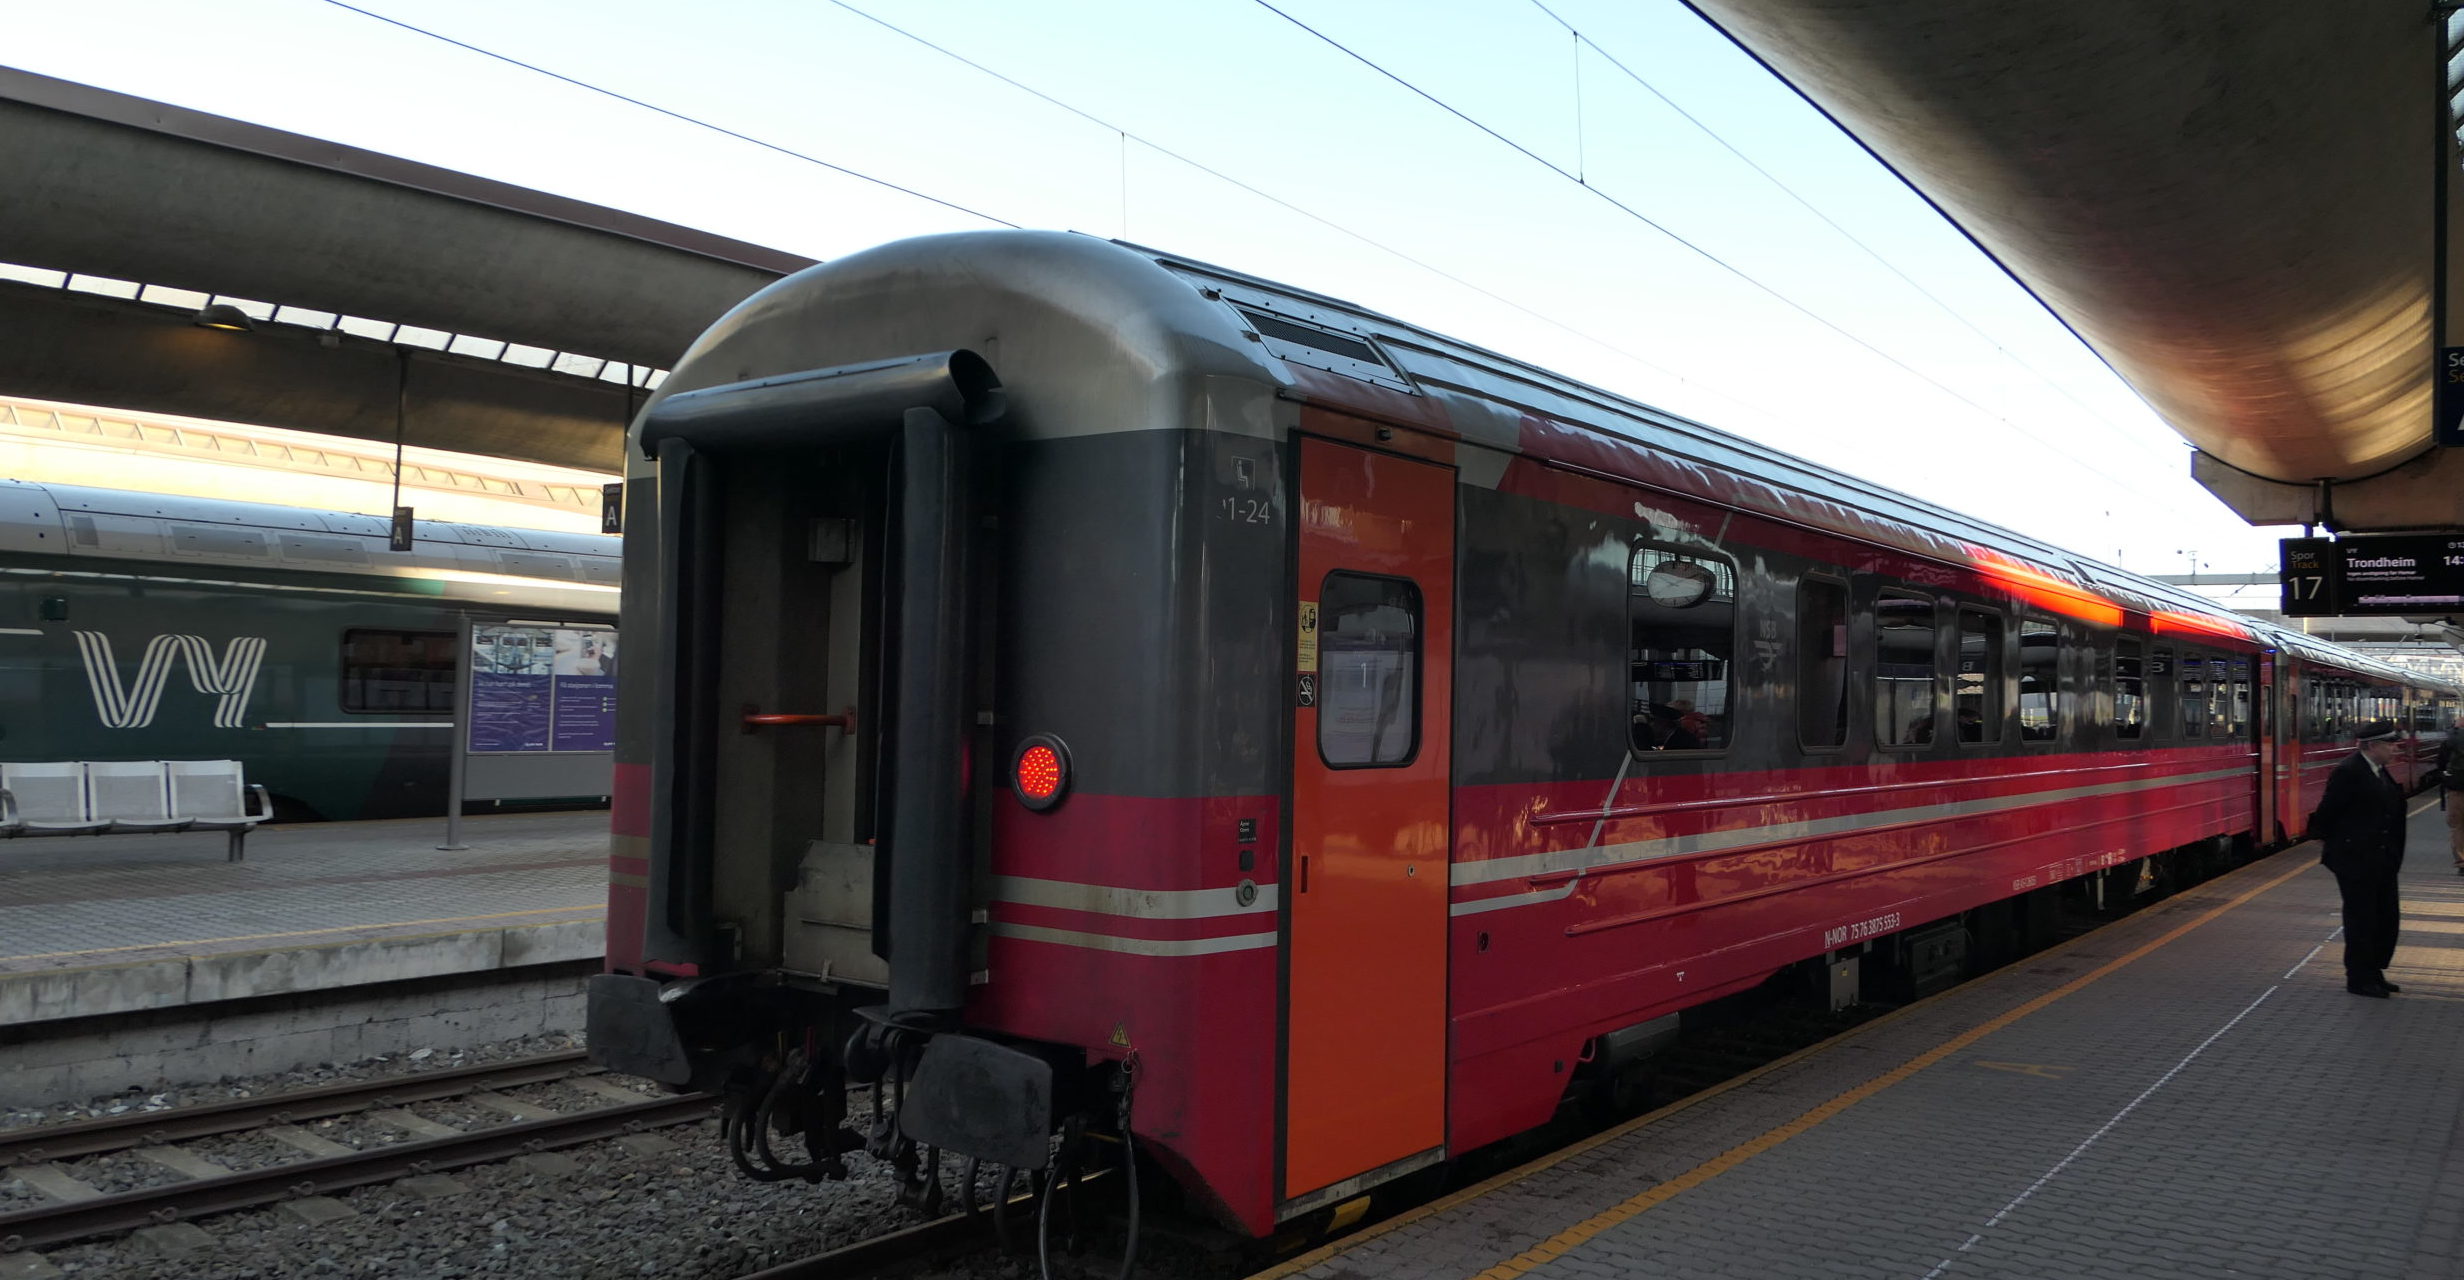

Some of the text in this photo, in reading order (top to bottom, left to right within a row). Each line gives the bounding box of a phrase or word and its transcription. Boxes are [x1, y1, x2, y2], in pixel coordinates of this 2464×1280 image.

[604, 506, 617, 527] A
[393, 527, 403, 545] A
[2290, 551, 2315, 562] Spor
[2291, 561, 2319, 569] Track
[2346, 557, 2416, 568] Trondheim
[2289, 576, 2322, 600] 17
[1824, 925, 1847, 948] N-NOR
[1851, 923, 1859, 939] 75
[1860, 921, 1868, 937] 76
[1868, 916, 1883, 935] 3875
